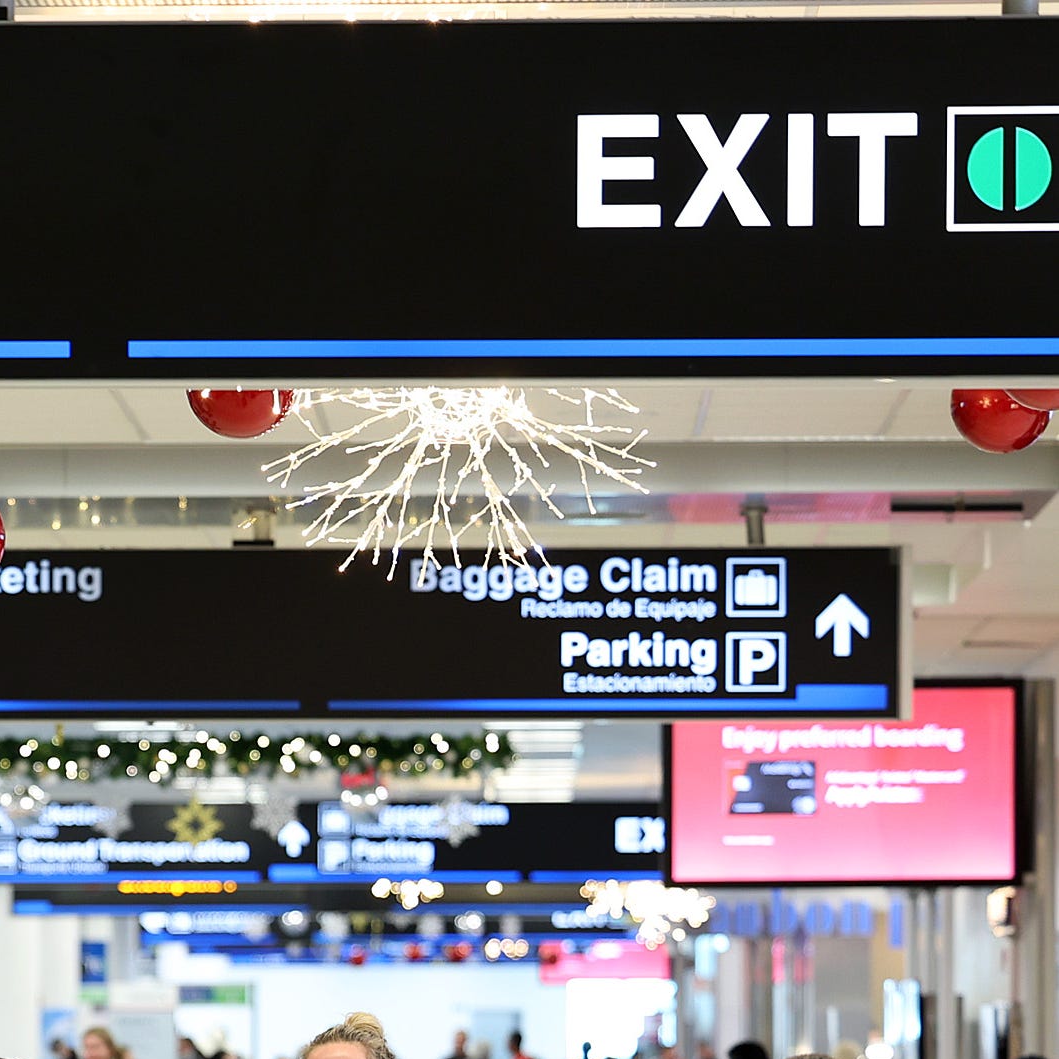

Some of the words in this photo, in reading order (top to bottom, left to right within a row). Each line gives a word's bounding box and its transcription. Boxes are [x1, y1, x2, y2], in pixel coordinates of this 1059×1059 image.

[576, 112, 918, 228] EXIT
[410, 556, 589, 601] Baggage
[600, 557, 717, 593] Claim
[520, 597, 603, 619] Reclamo
[605, 597, 631, 619] de
[634, 597, 717, 622] Equipaje
[560, 631, 718, 674] Parking
[738, 639, 777, 686] P
[562, 672, 717, 694] Estacionamiento
[614, 816, 666, 854] EX
